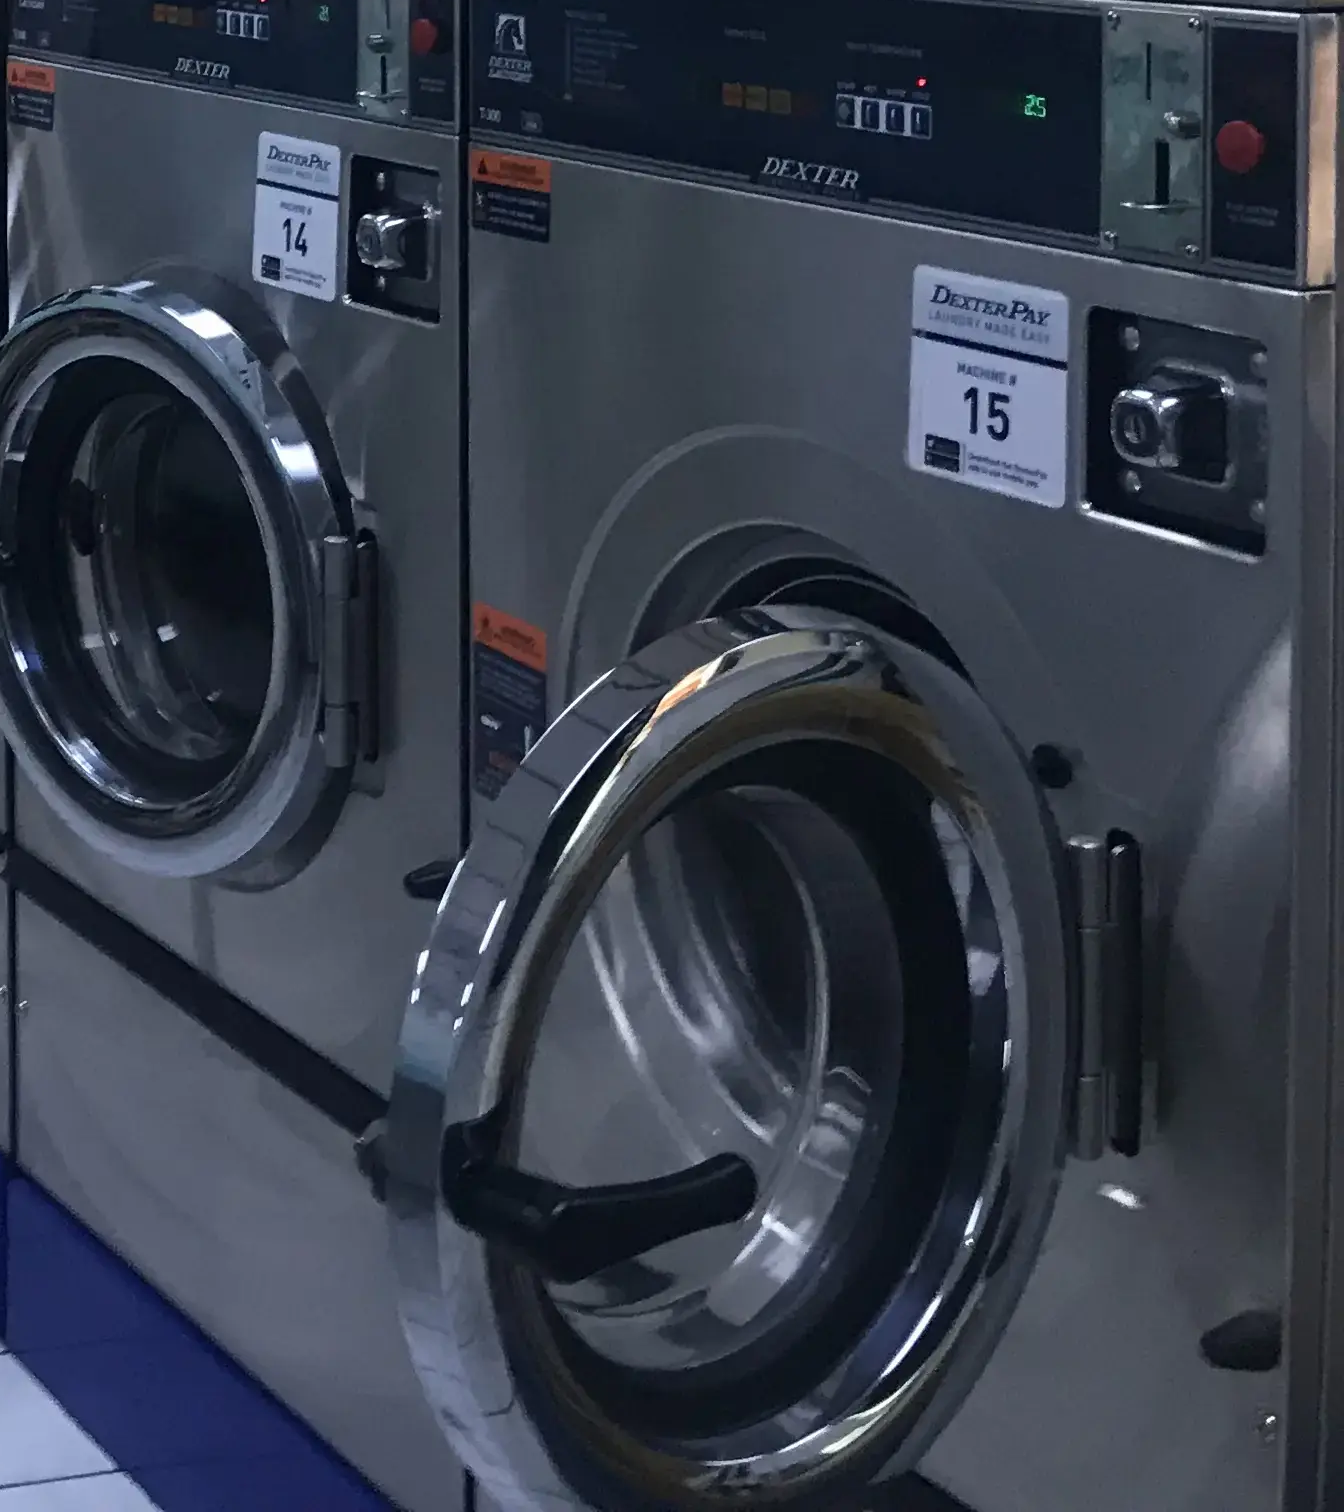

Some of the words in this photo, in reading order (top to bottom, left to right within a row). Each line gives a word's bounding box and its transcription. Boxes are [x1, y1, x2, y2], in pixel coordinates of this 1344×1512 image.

[174, 56, 231, 80] DEXTER
[1023, 92, 1048, 119] 25
[761, 155, 861, 190] DEXTER
[282, 217, 308, 258] 14
[956, 361, 1006, 385] MACHINE
[963, 386, 1010, 442] 15
